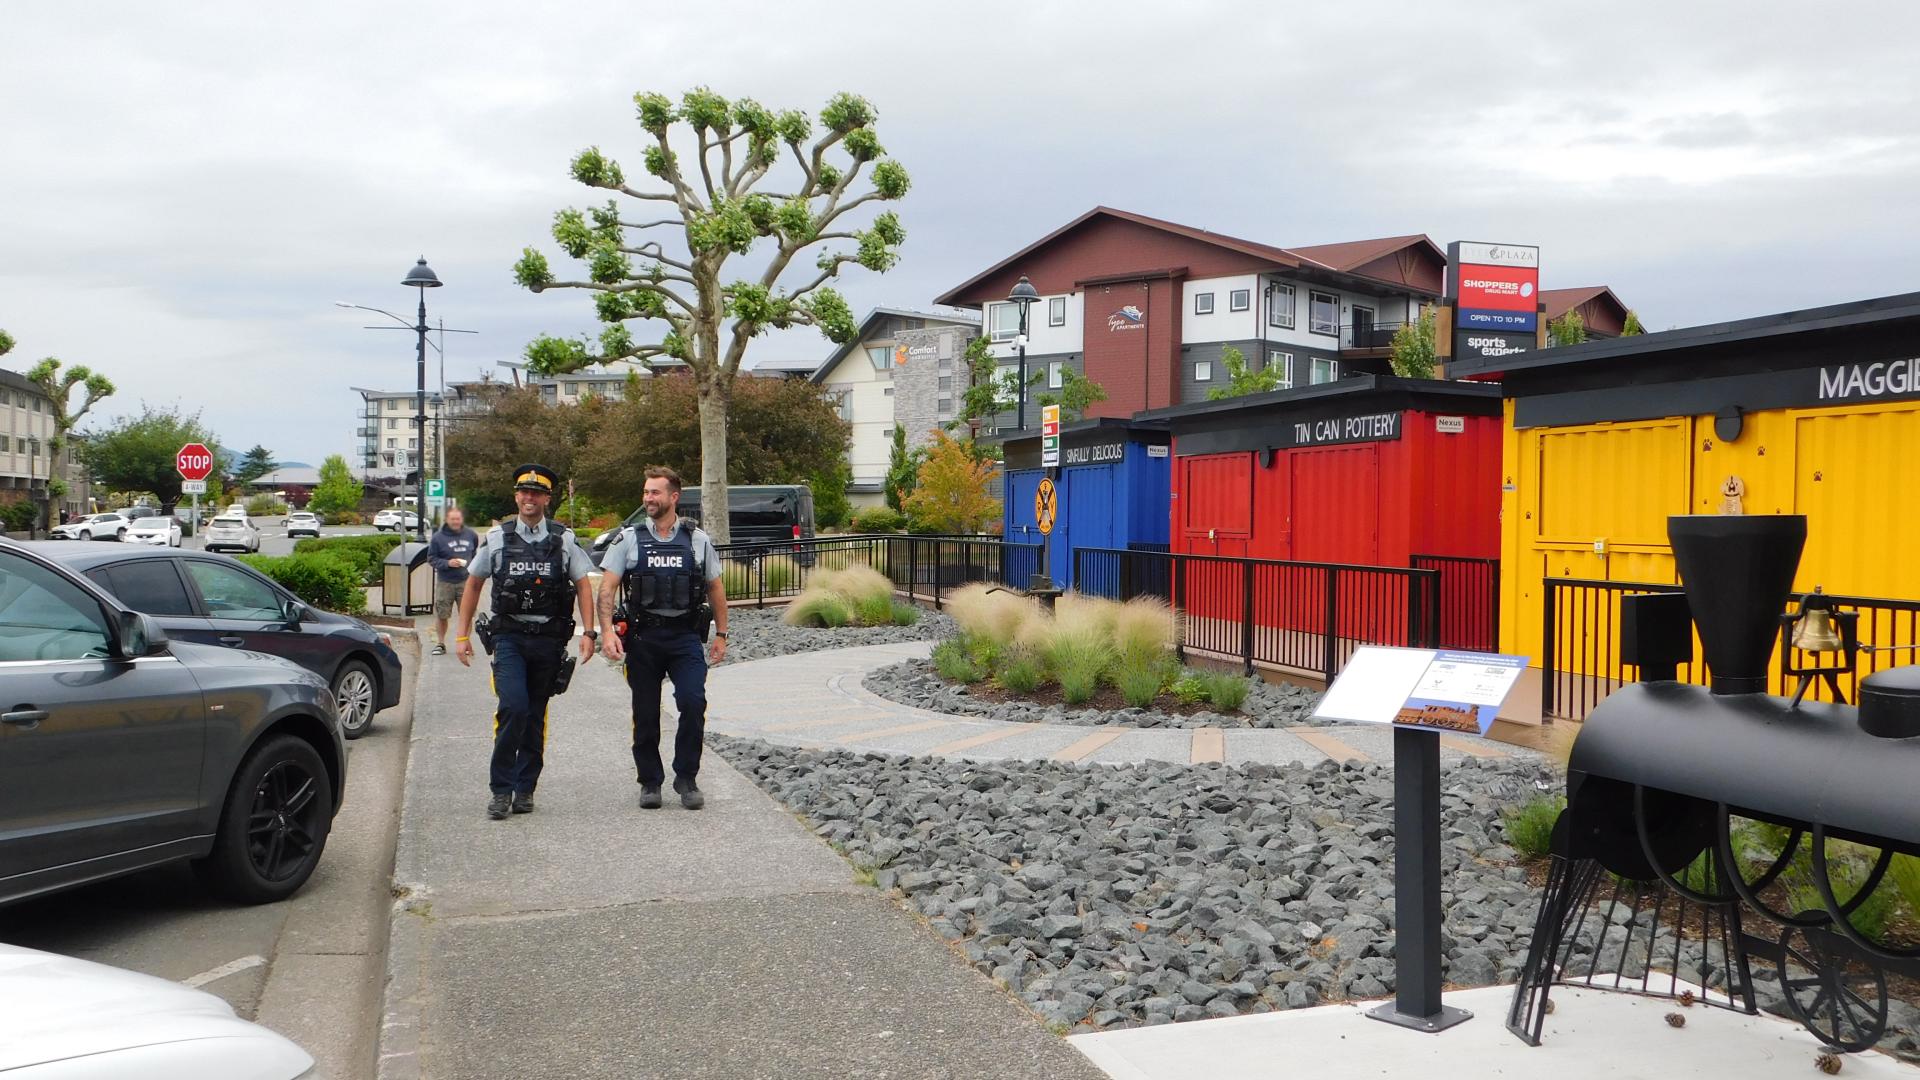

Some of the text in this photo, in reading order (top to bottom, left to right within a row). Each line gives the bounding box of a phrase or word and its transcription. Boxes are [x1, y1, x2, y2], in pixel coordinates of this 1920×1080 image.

[1500, 250, 1534, 260] PLAZA
[1464, 280, 1518, 290] SHOPPERS
[1470, 314, 1491, 322] OPEN
[1492, 315, 1504, 323] TO
[1467, 337, 1506, 349] sports
[908, 345, 937, 355] Comfort
[1294, 413, 1396, 444] TIN CAN POTTERY
[1067, 444, 1122, 463] SINFULLY DELICIOUS
[180, 455, 210, 469] STOP
[428, 481, 441, 495] P
[509, 562, 551, 571] POLICE
[647, 556, 682, 568] POLICE
